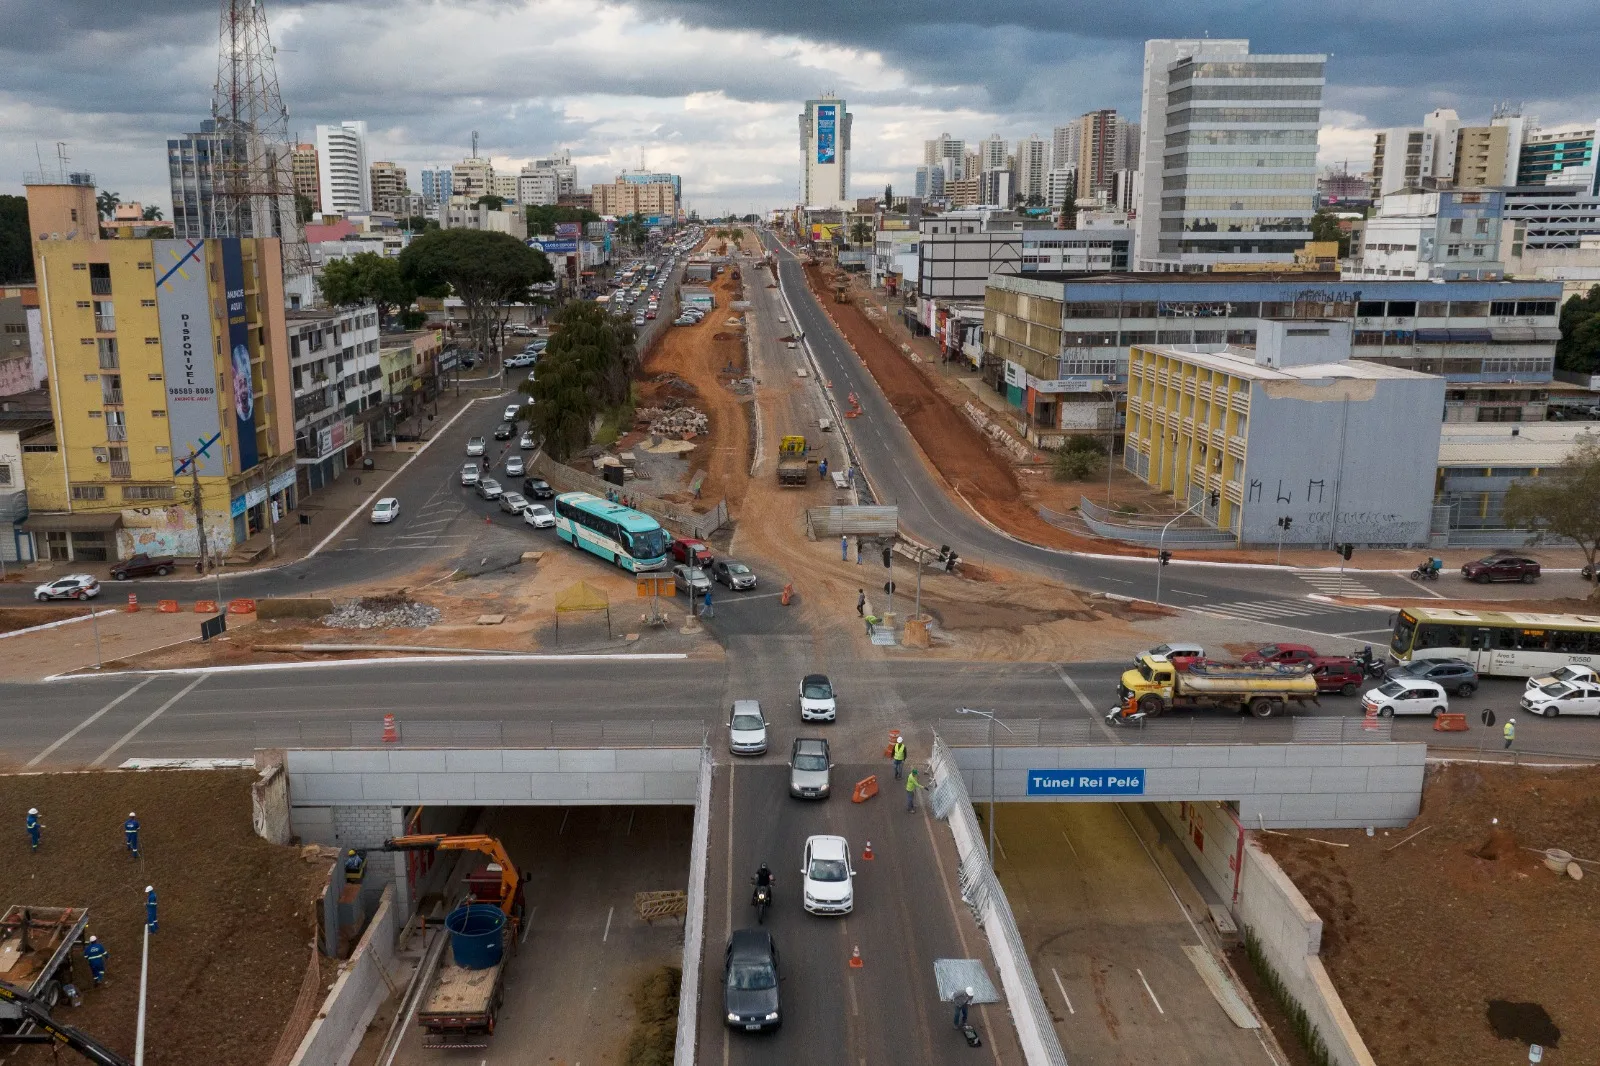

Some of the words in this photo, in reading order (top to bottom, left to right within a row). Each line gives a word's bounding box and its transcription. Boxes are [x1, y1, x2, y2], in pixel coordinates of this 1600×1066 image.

[181, 314, 194, 384] DISPONIVEL
[1033, 777, 1074, 787] Túnel
[1079, 776, 1103, 787] Rei
[1107, 776, 1140, 787] Pelé
